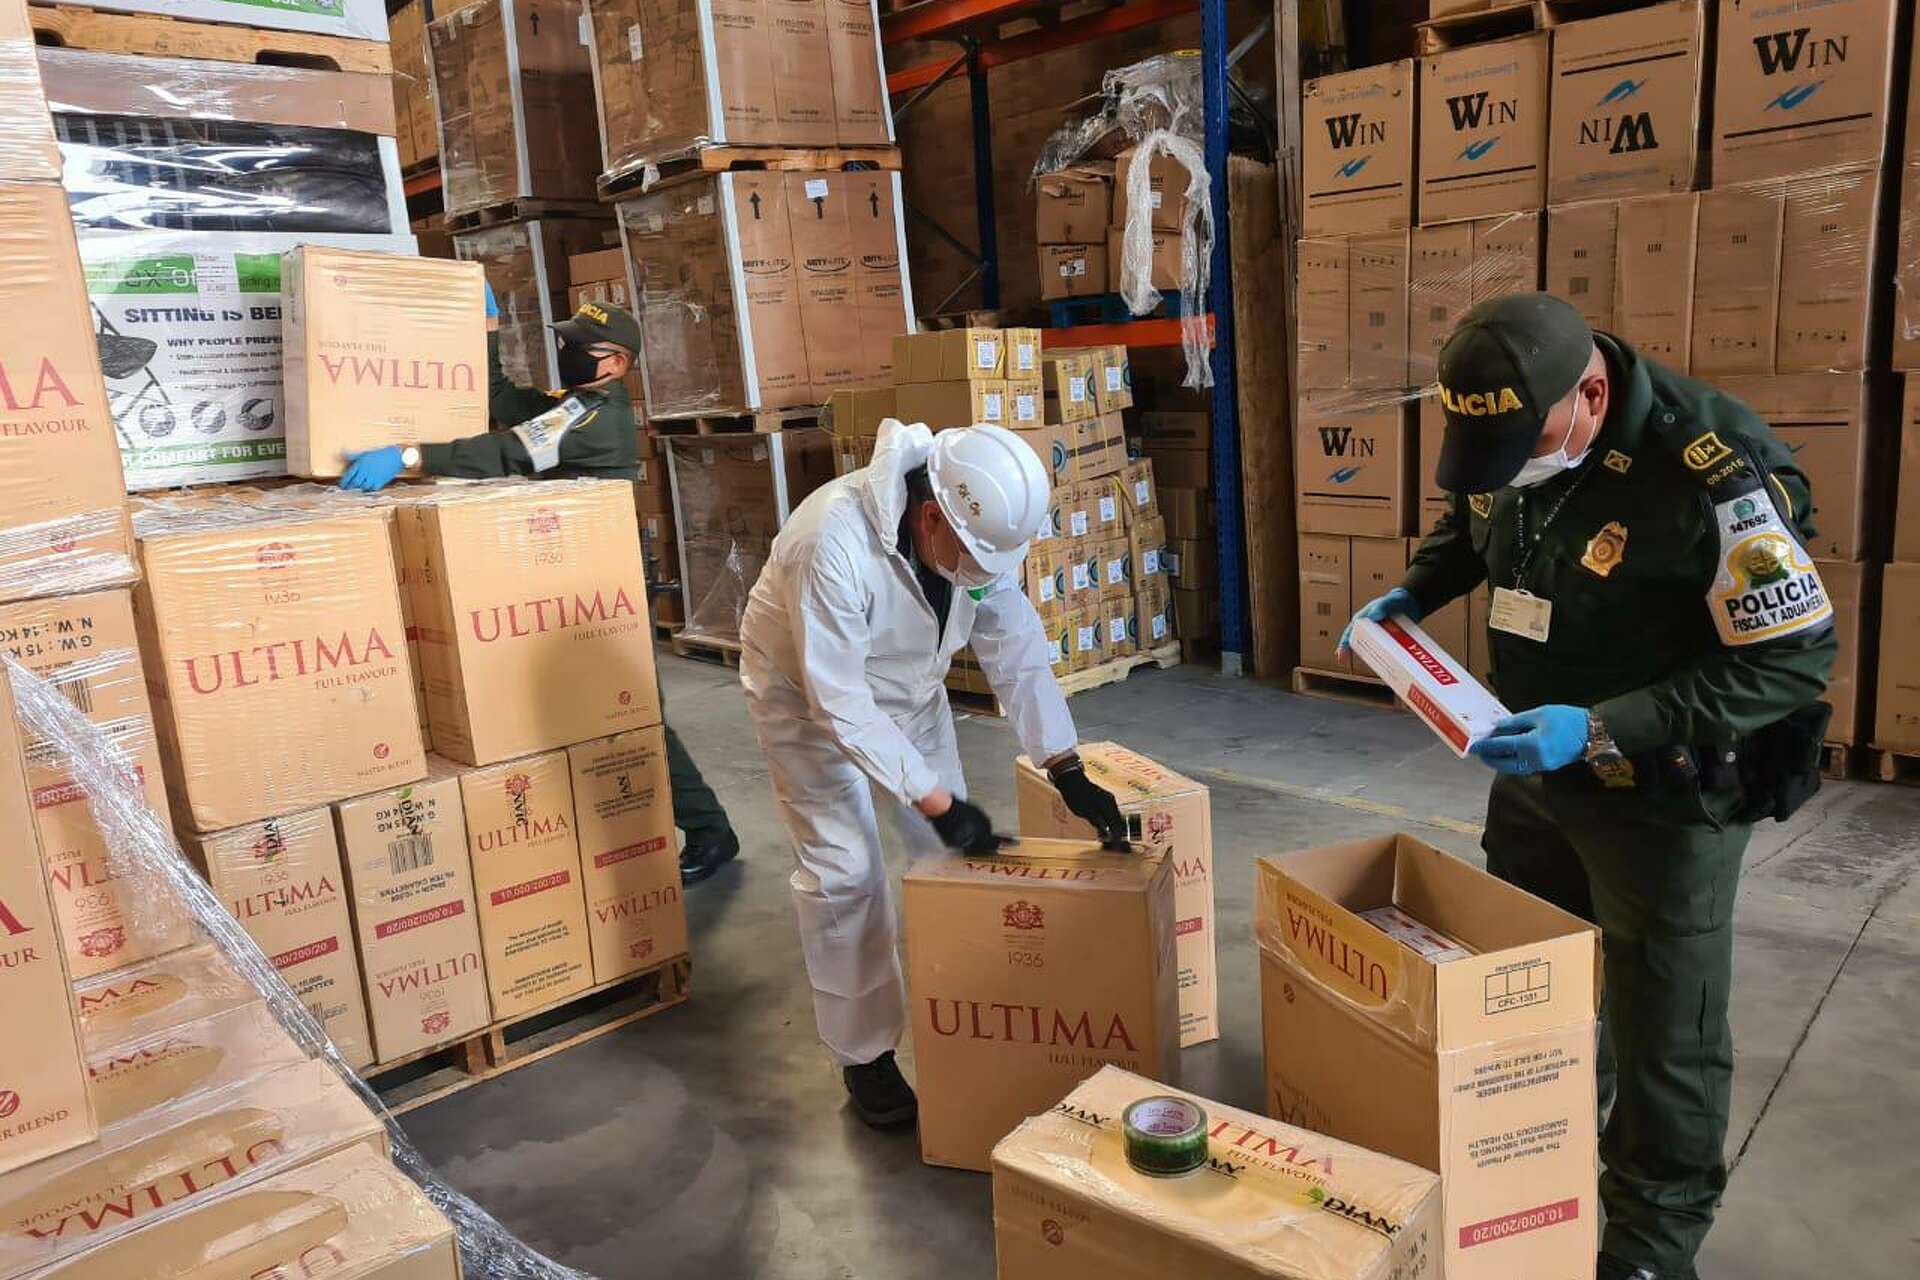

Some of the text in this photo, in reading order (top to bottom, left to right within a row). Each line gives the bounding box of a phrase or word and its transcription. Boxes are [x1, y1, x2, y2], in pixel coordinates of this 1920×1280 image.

[124, 308, 215, 323] SITTING
[222, 308, 242, 321] IS
[166, 338, 194, 347] WHY
[198, 337, 242, 346] PEOPLE
[317, 354, 477, 393] ULTIMA
[3, 418, 92, 437] FLAVOUR
[222, 445, 252, 459] FOR
[1728, 513, 1769, 535] 147692
[470, 586, 638, 643] ULTIMA
[1724, 573, 1819, 618] POLICIA
[1732, 613, 1766, 634] FISCAL
[1768, 610, 1778, 623] Y
[180, 627, 397, 695] ULTIMA
[478, 813, 569, 852] ULTIMA
[596, 885, 677, 924] ULTIMA
[1007, 950, 1045, 969] 1936
[1287, 906, 1389, 1004] ULTIMA
[375, 952, 479, 998] ULTIMA
[926, 997, 1139, 1053] ULTIMA
[17, 1109, 69, 1136] BLEND
[23, 1139, 284, 1242] ULTIMA
[1321, 1196, 1398, 1235] DIAN
[1472, 1206, 1565, 1242] 10,000/200/20
